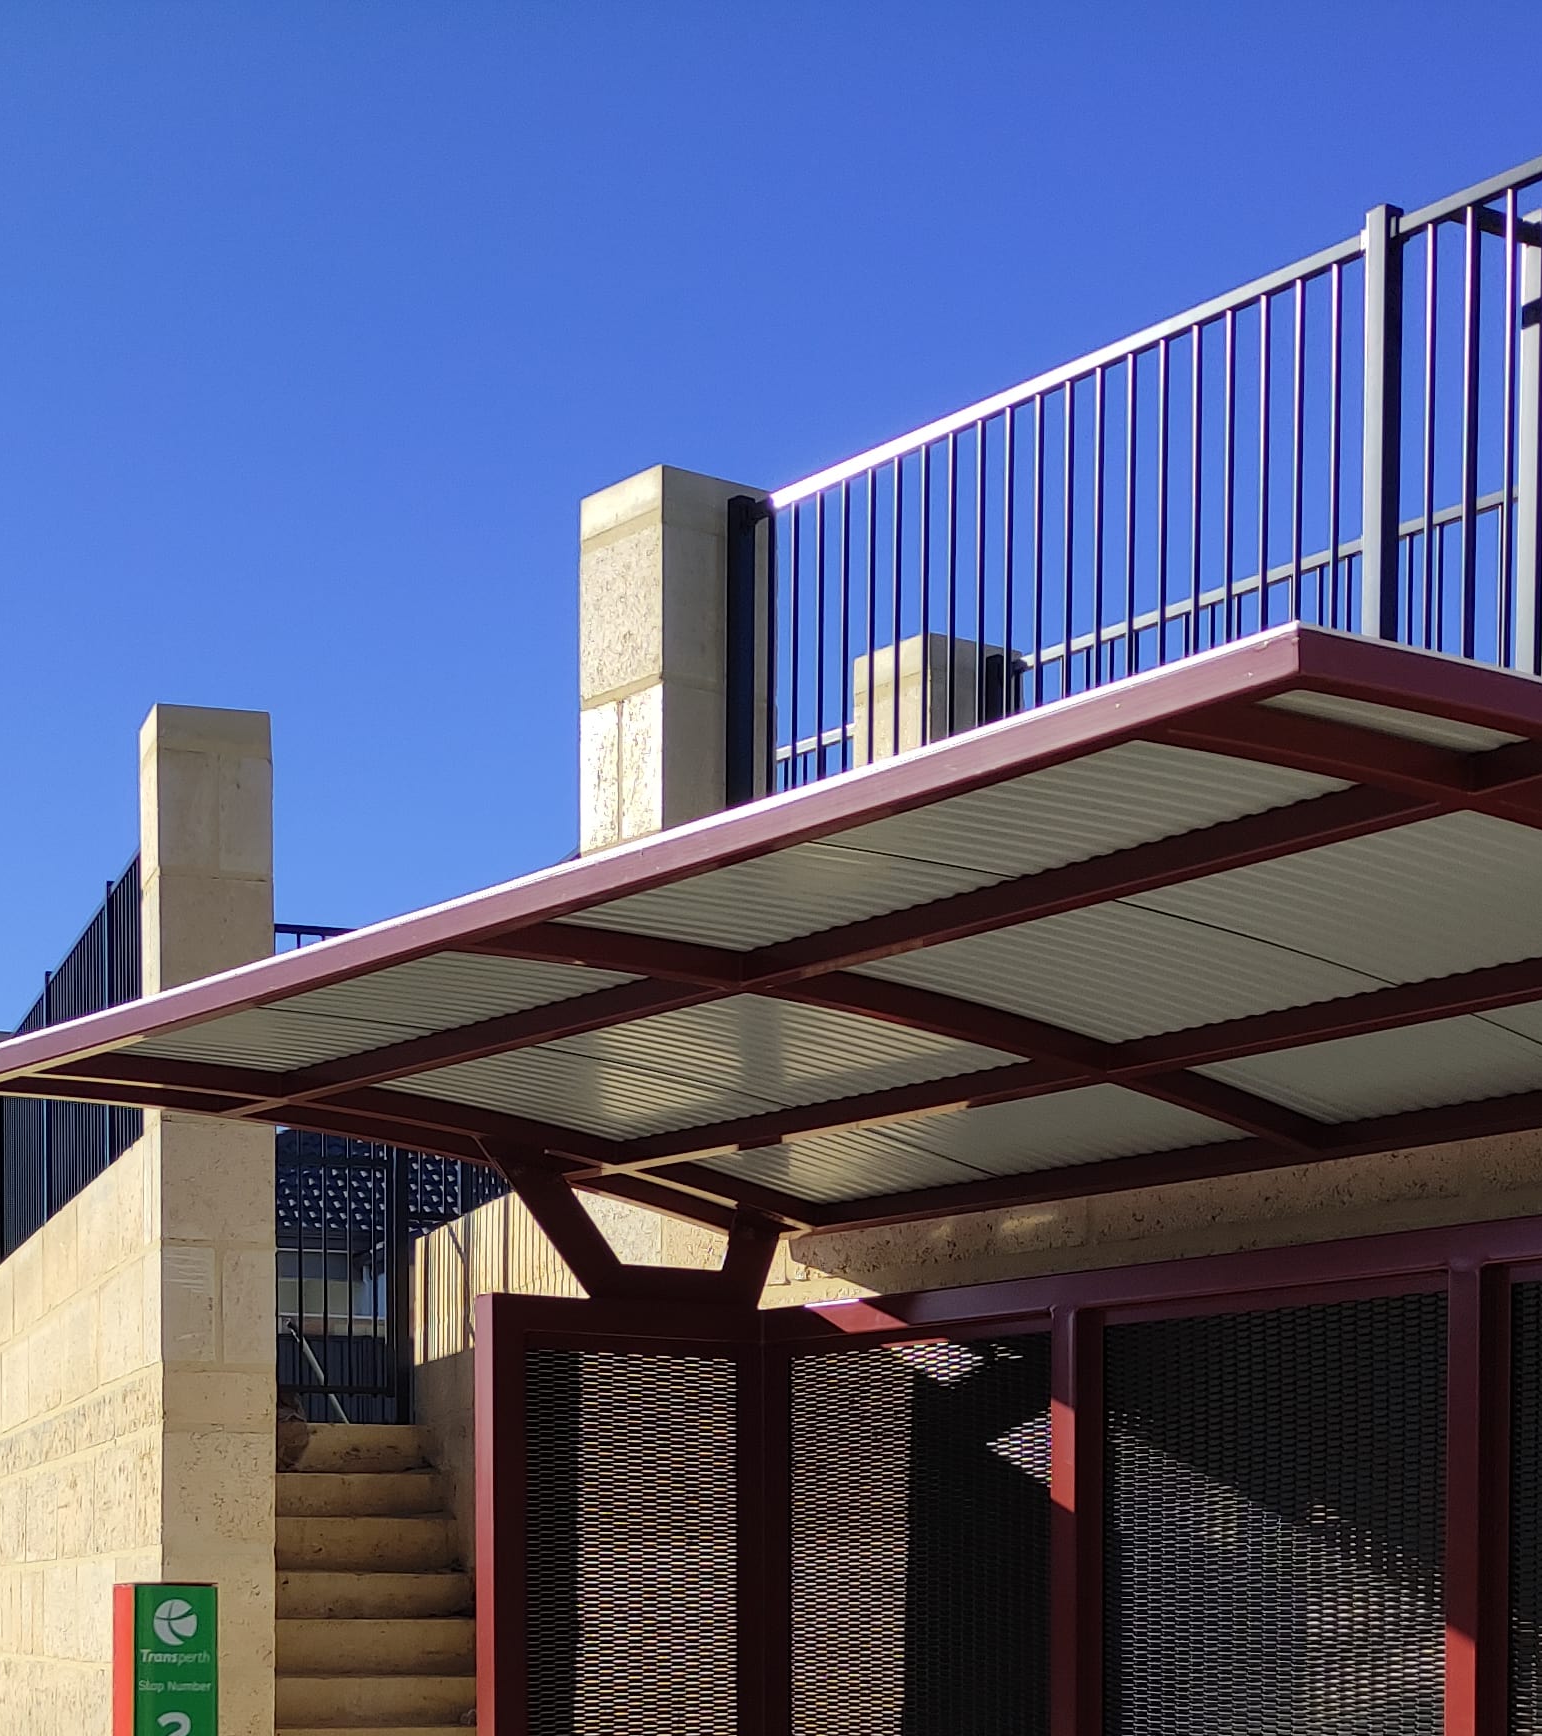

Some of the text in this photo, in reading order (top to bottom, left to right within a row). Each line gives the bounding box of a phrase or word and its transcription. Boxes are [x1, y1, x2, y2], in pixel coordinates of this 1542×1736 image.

[140, 1648, 211, 1666] Transperth
[139, 1679, 212, 1693] Stop Number
